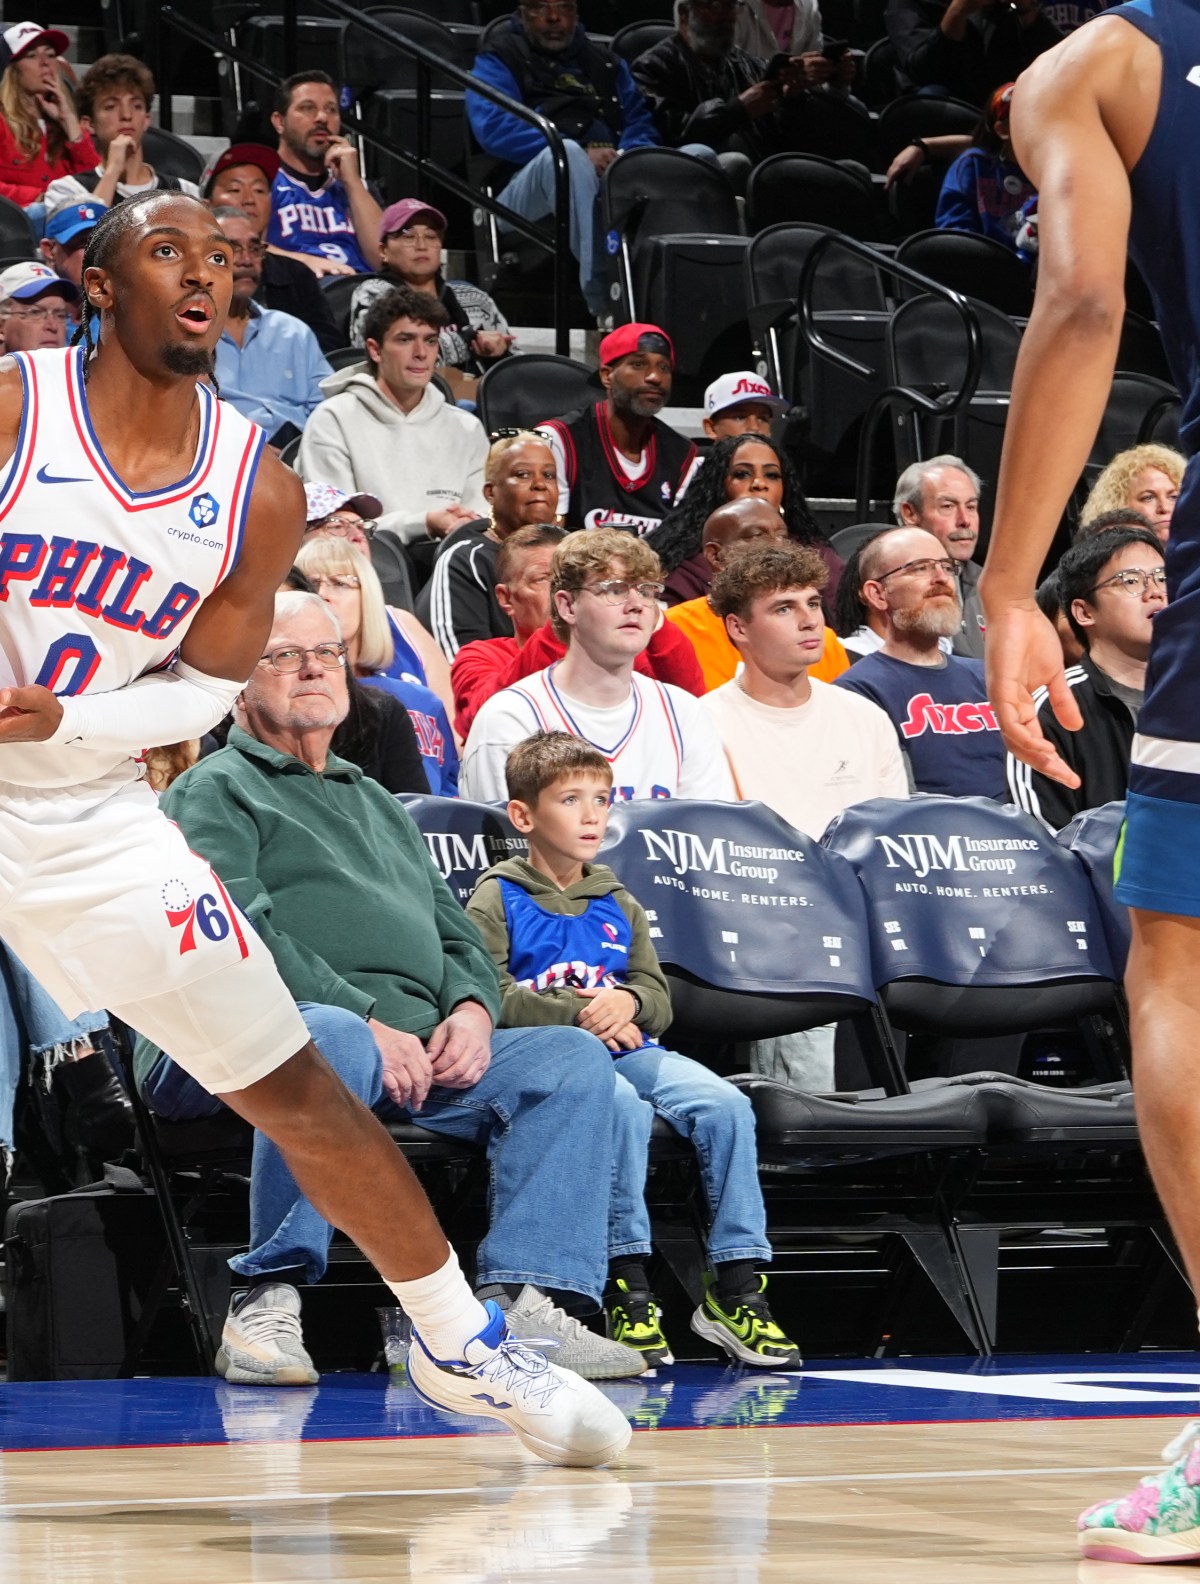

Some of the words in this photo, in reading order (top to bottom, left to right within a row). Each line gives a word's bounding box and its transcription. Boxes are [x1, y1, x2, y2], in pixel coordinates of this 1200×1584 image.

[167, 527, 224, 550] crypto.com
[35, 632, 102, 697] 0
[638, 829, 731, 875] NJM
[728, 841, 805, 862] Insurance
[875, 834, 970, 877] NJM
[963, 836, 1039, 852] Insurance
[968, 856, 1017, 874] Group
[730, 861, 779, 884] Group
[654, 875, 690, 893] AUTO.
[692, 887, 735, 902] HOME.
[741, 894, 814, 907] RENTERS.
[895, 882, 932, 895] AUTO.
[936, 886, 977, 898] HOME.
[983, 884, 1054, 898] RENTERS.
[164, 893, 230, 956] 76
